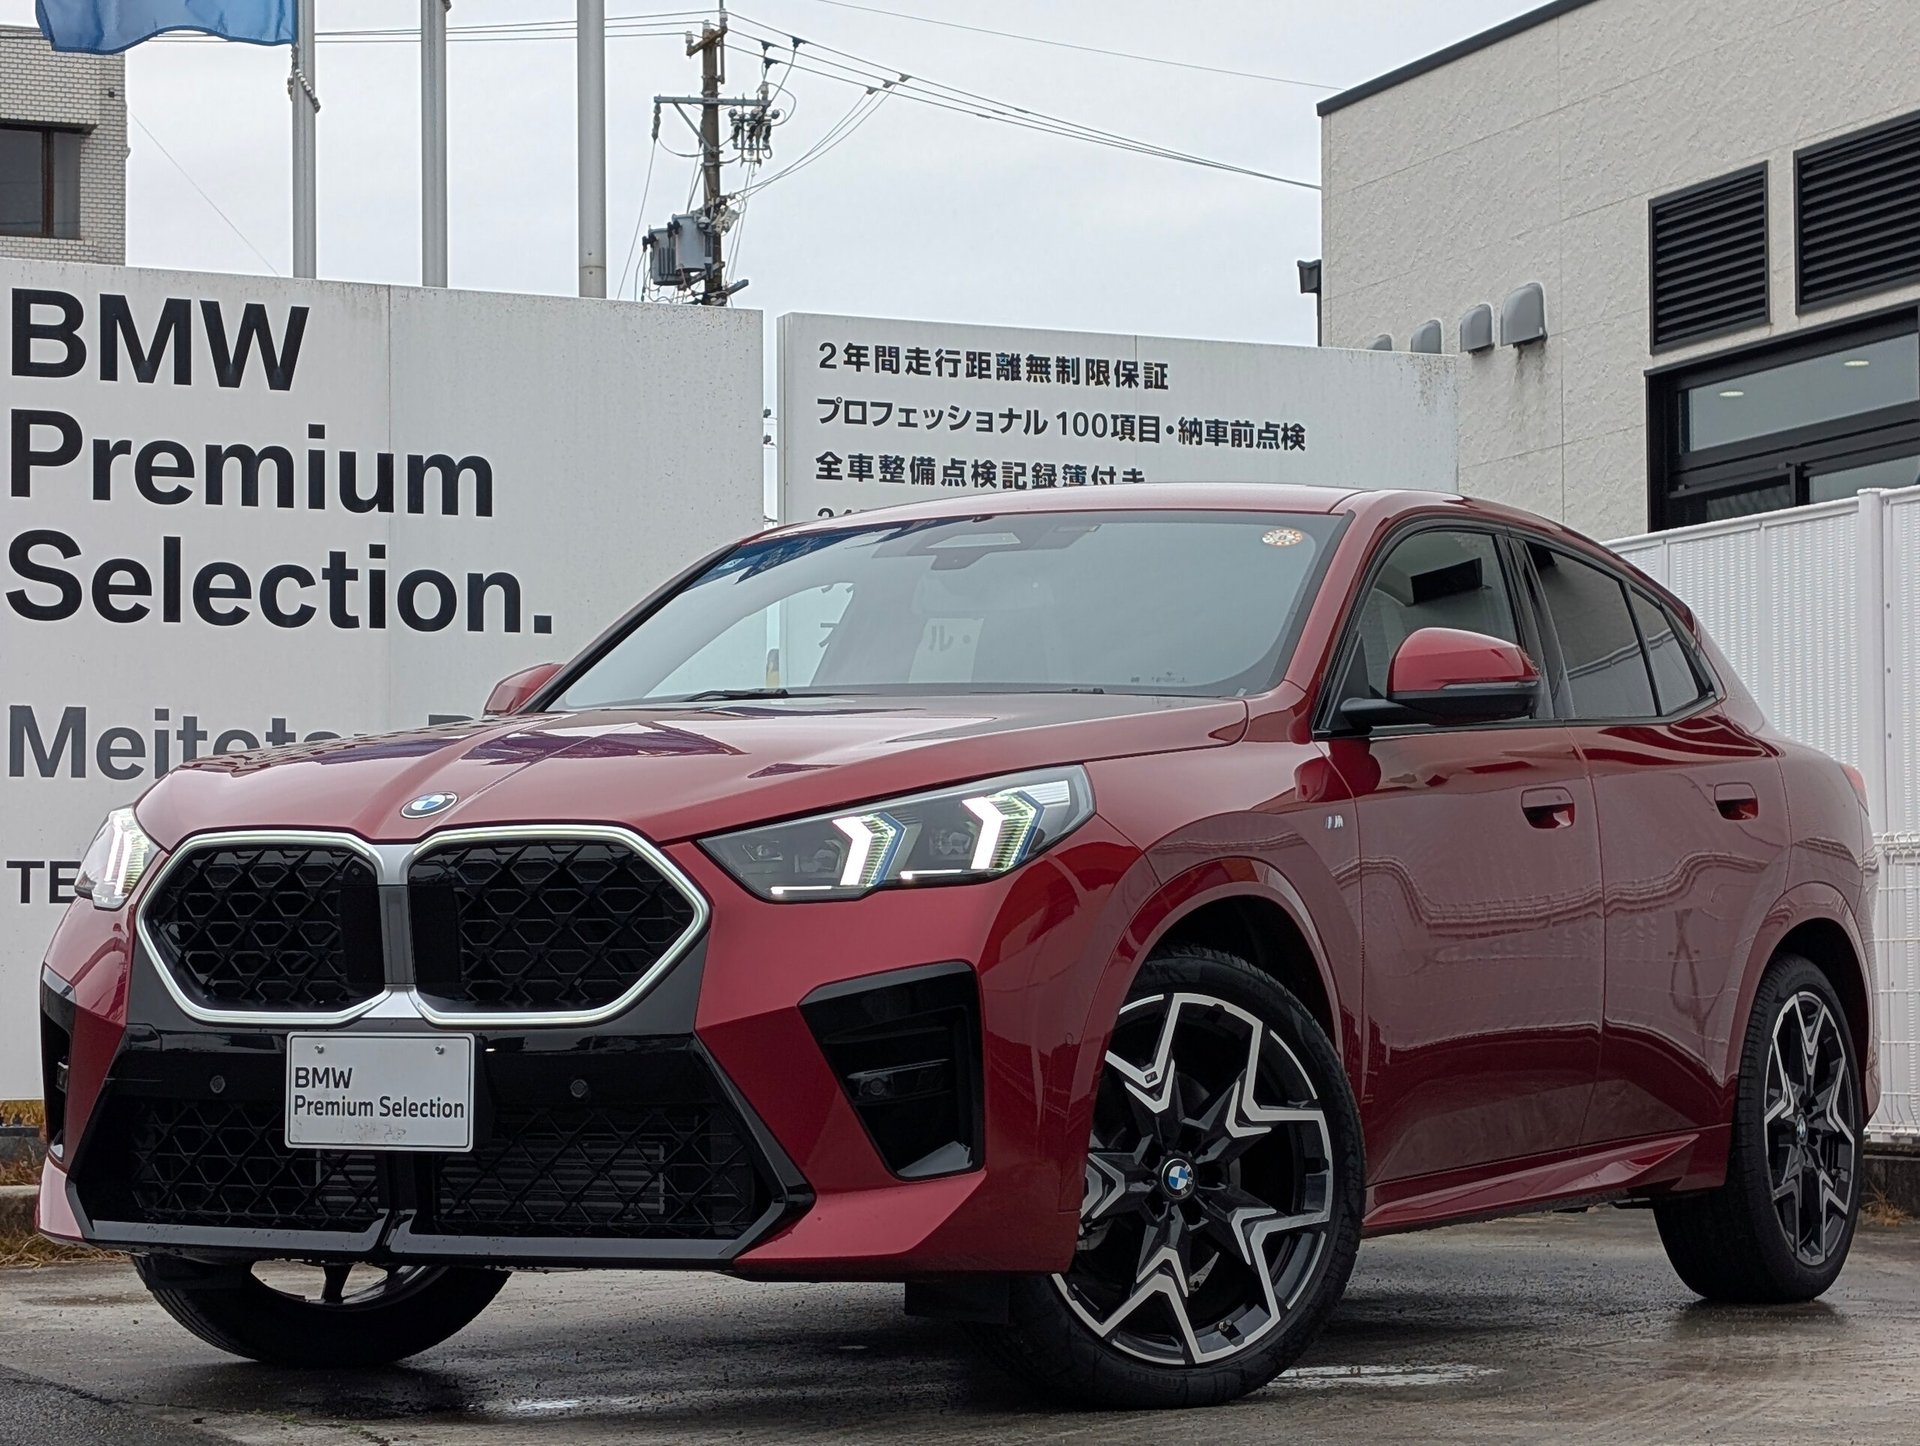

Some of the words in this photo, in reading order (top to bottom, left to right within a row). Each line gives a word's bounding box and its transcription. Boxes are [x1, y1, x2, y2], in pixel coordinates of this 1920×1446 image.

[10, 287, 310, 391] BMW
[819, 343, 1169, 390] 2年間走行距離無制限保証
[10, 408, 494, 517] Premium
[5, 529, 552, 634] Selection.
[6, 860, 81, 904] TE
[294, 1067, 353, 1089] BMW
[294, 1095, 374, 1117] Premium
[379, 1096, 465, 1119] Selection
